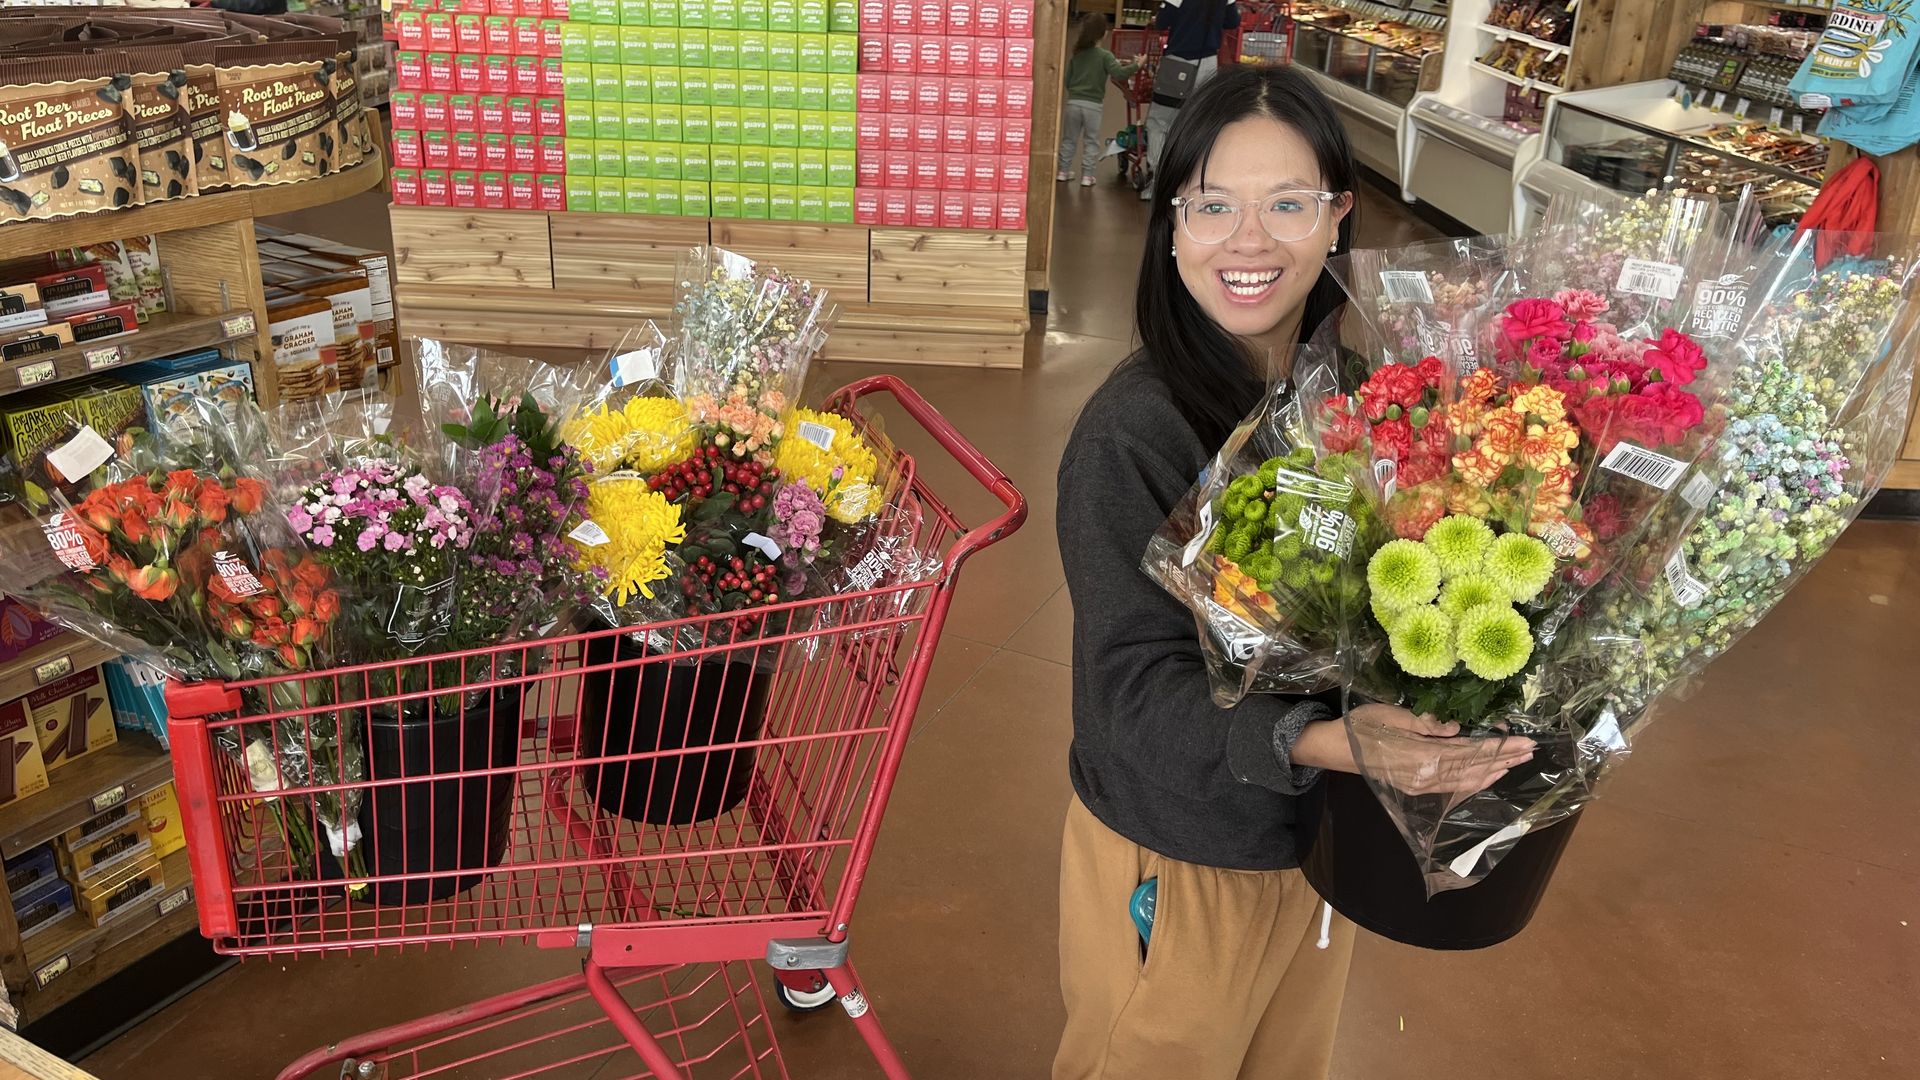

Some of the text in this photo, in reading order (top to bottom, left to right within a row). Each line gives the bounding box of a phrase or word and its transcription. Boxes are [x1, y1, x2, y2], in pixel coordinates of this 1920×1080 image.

[652, 2, 675, 10] guava
[490, 35, 509, 43] berry
[742, 45, 764, 53] guava
[772, 47, 794, 55] guava
[242, 81, 299, 104] Root Beer
[195, 94, 220, 109] Piec
[263, 89, 324, 116] Float Pieces
[0, 106, 33, 126] Root
[34, 101, 72, 119] Beer
[133, 102, 171, 118] Pieces
[21, 108, 113, 140] Float Pieces
[512, 116, 531, 124] berry
[598, 115, 620, 123] guava
[656, 118, 678, 126] guava
[598, 190, 620, 198] guava
[1697, 289, 1747, 307] 90%
[334, 312, 355, 322] ACKER
[1694, 309, 1741, 323] RECYCLED
[1691, 317, 1738, 333] PLASTIC
[283, 336, 316, 350] CRACKER
[284, 330, 314, 343] GRAHAM
[22, 341, 41, 353] DARK
[12, 413, 27, 433] the
[1315, 509, 1344, 552] 90%
[863, 551, 886, 579] 90%
[230, 582, 263, 594] PLASTIC
[147, 789, 168, 803] FLAKES
